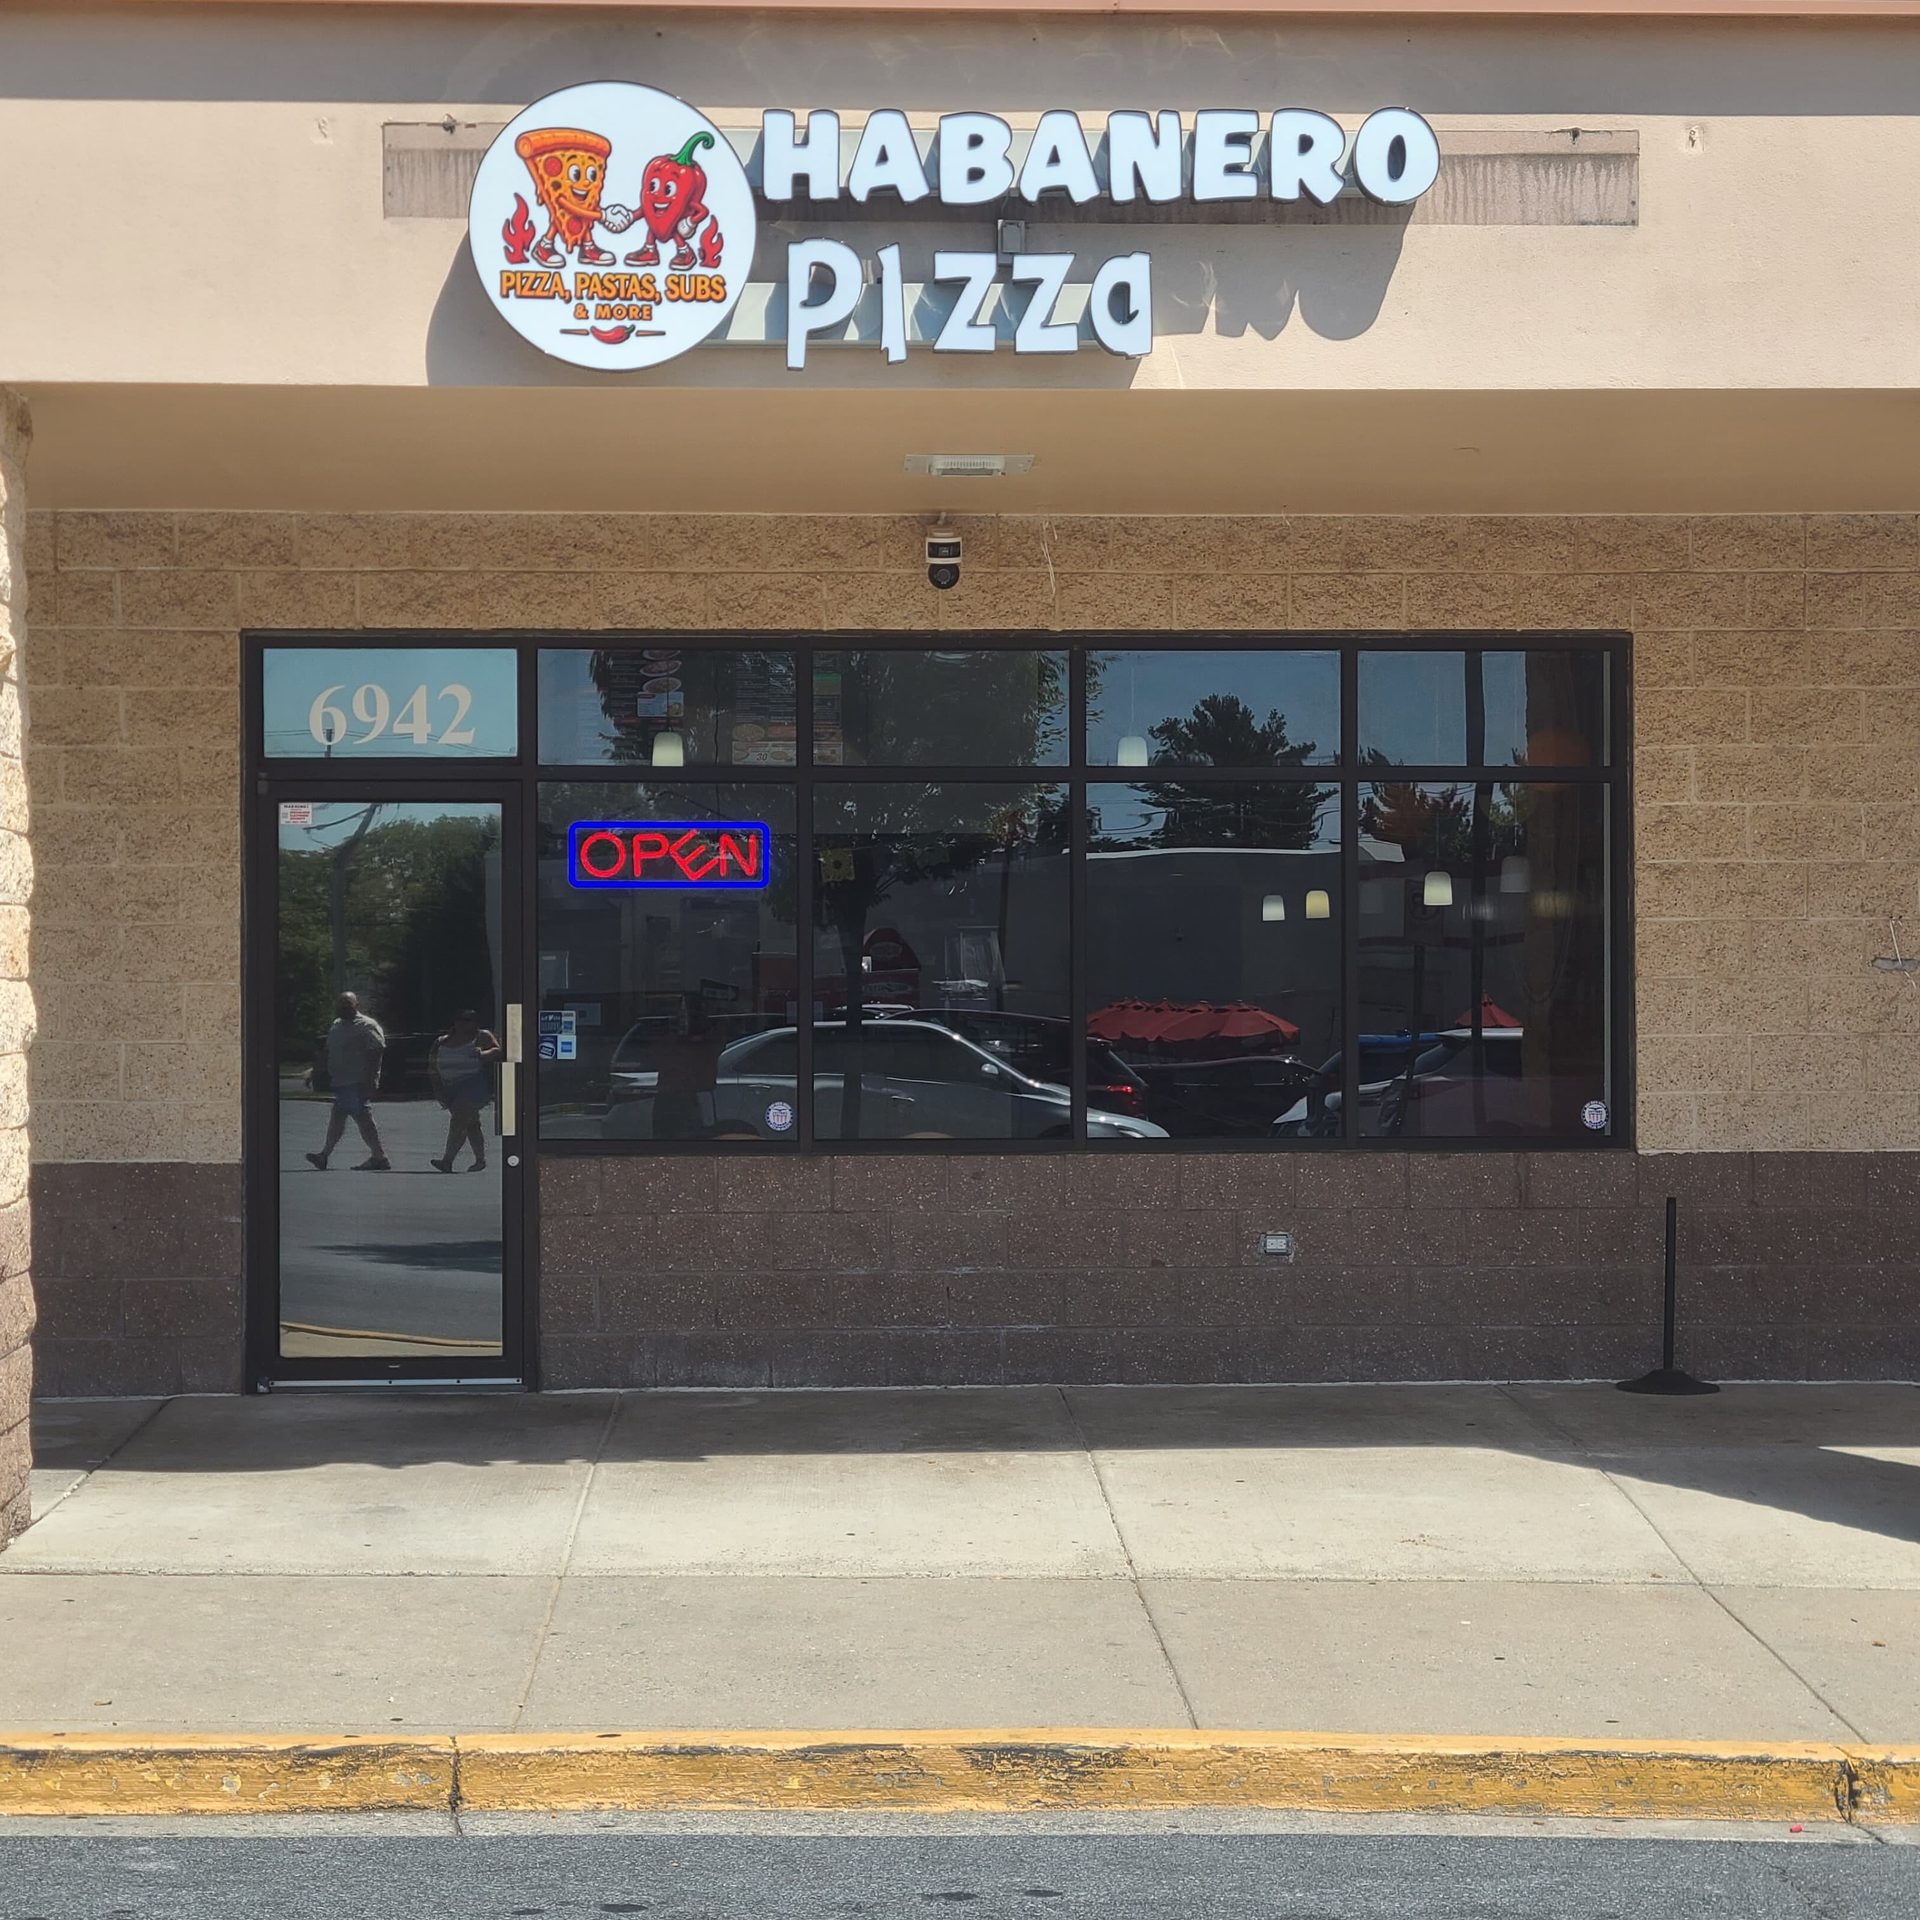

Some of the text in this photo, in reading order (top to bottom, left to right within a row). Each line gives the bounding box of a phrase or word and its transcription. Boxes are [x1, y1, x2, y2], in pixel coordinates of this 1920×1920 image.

[762, 107, 1441, 206] HABANERO
[500, 271, 727, 304] PIZZA, PASTAS, SUBS
[573, 303, 653, 320] & MORE
[309, 684, 476, 746] 6942
[580, 828, 757, 881] OPEN
